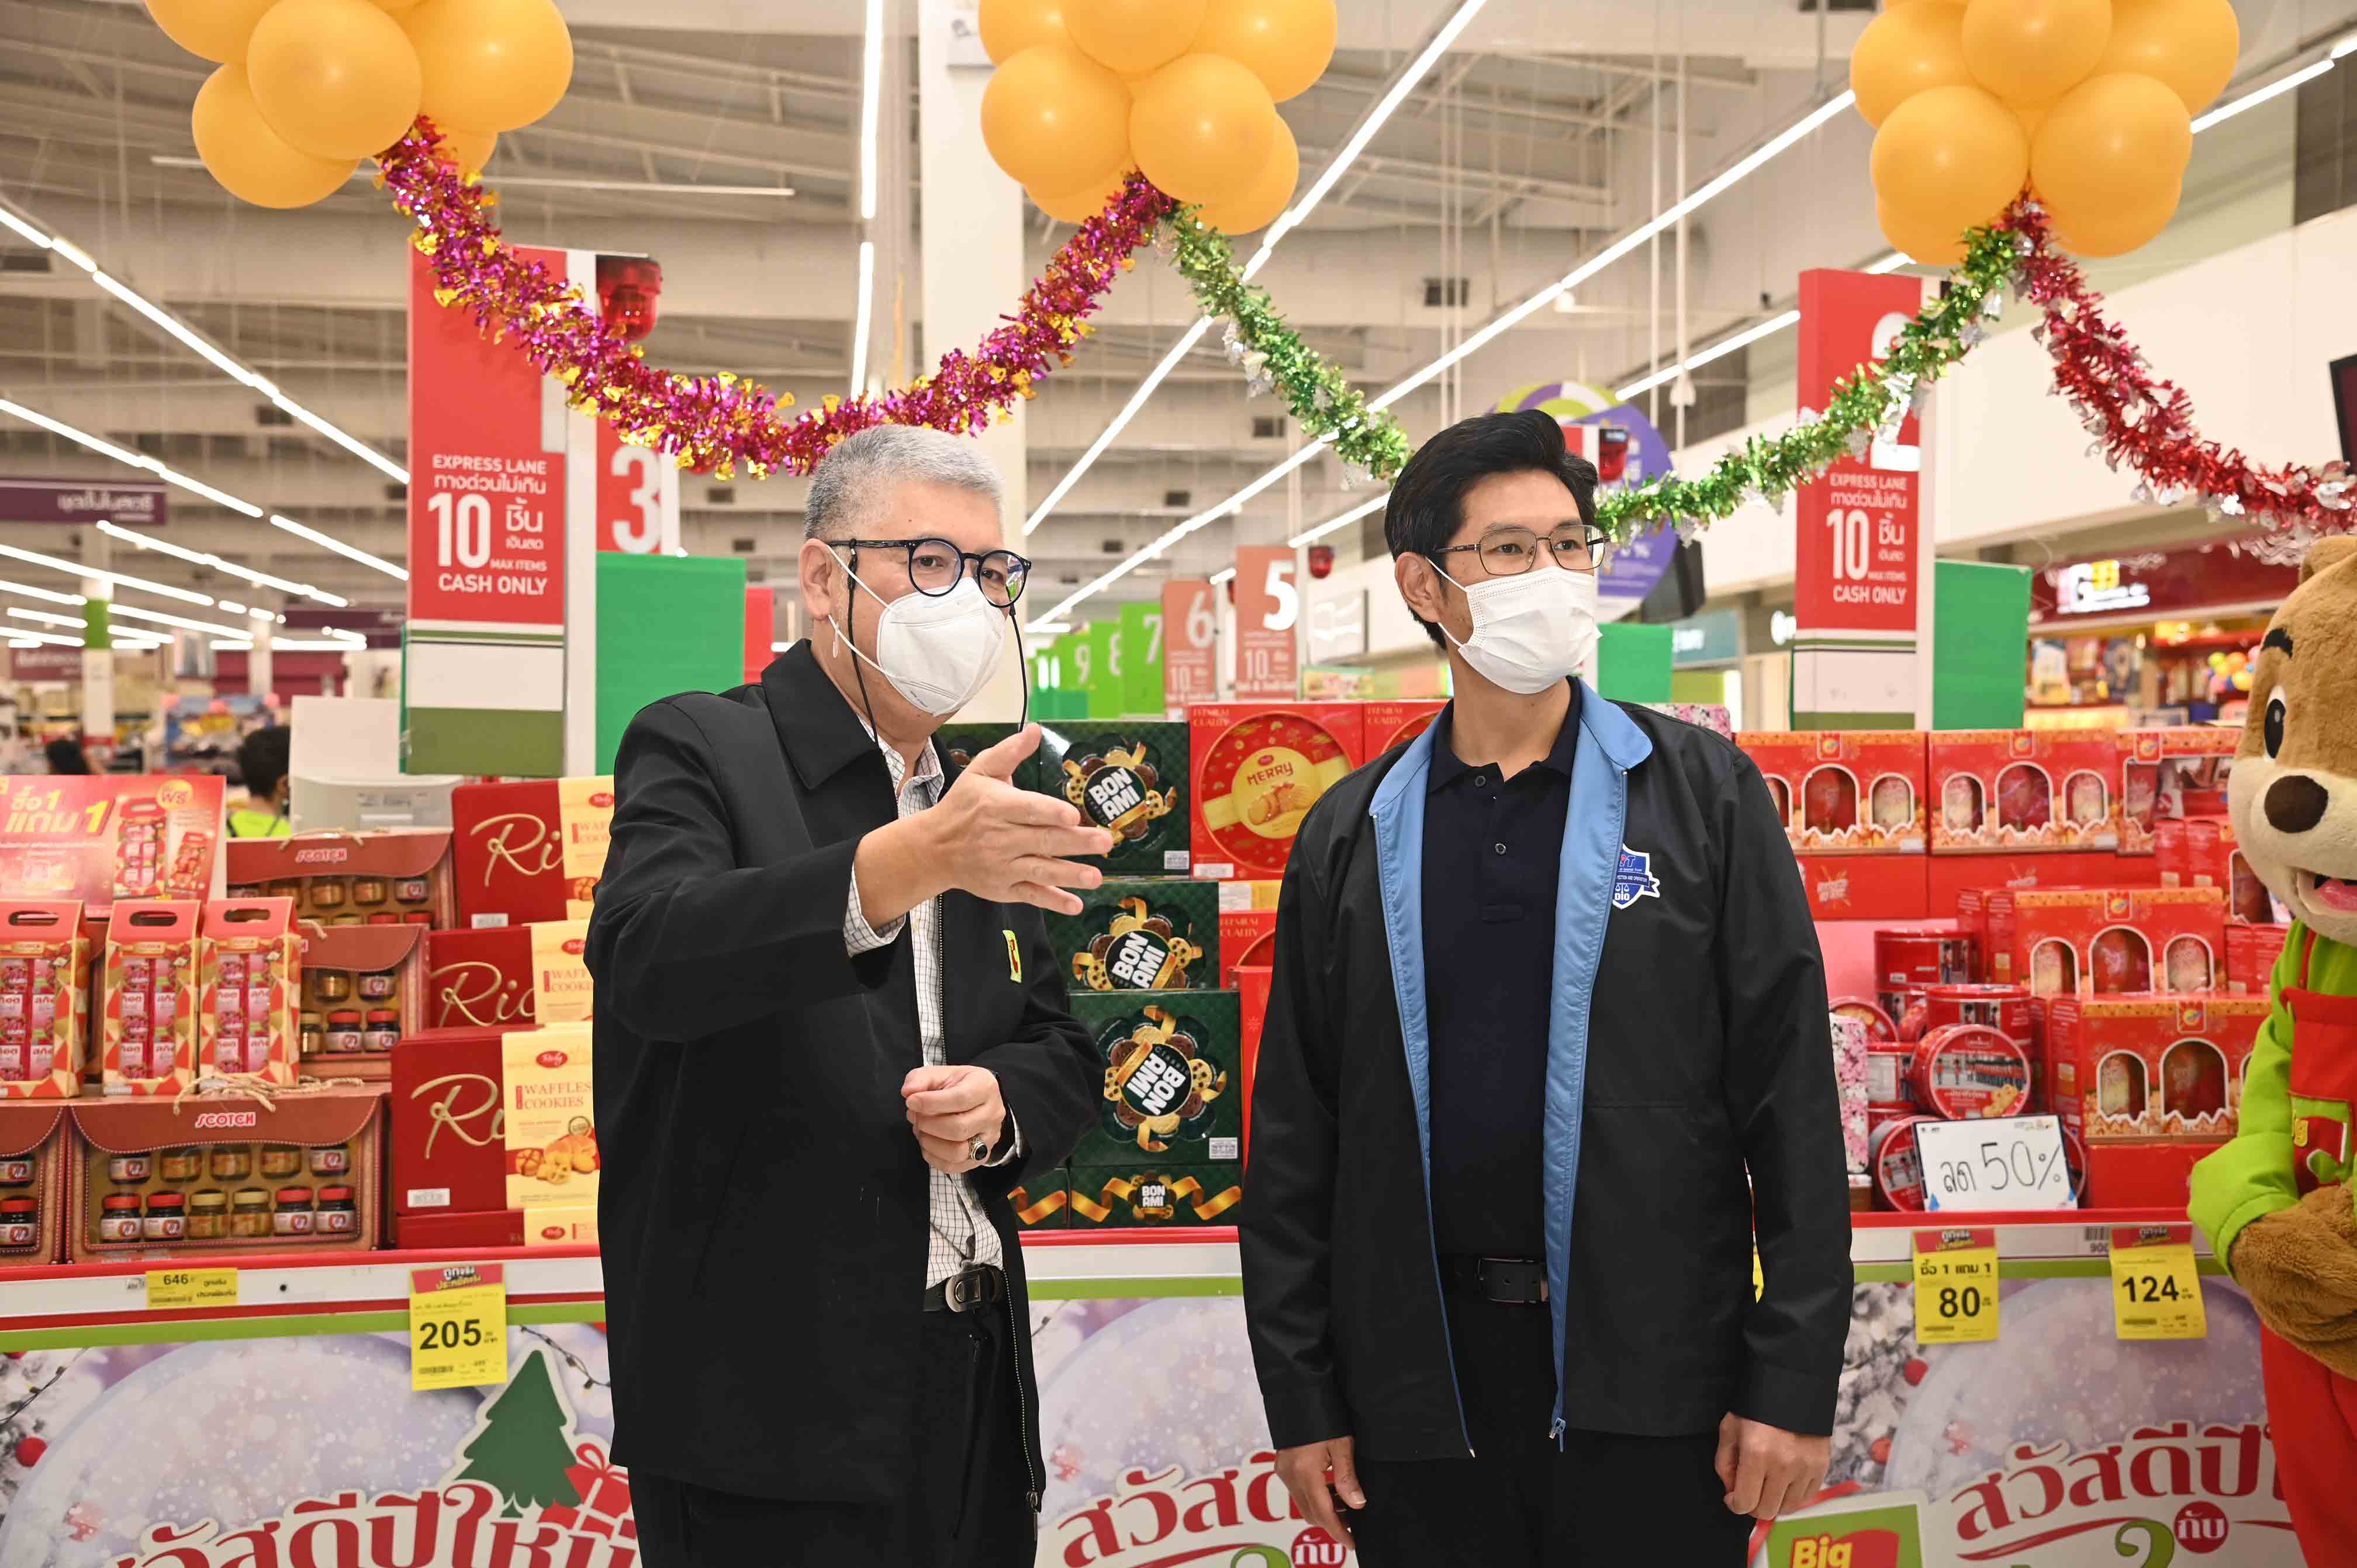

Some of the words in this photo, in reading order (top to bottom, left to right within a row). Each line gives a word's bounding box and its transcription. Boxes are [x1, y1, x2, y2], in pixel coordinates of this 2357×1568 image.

[433, 454, 502, 472] EXPRESS
[506, 459, 547, 475] LANE
[1830, 472, 1878, 489] EXPRESS
[1879, 476, 1908, 491] LANE
[505, 497, 544, 532] ชิ้น
[610, 445, 661, 555] 3
[428, 492, 491, 569] 10
[1826, 508, 1869, 580] 10
[1878, 511, 1905, 545] ชิ้น
[490, 558, 514, 570] MAX
[516, 559, 547, 572] ITEMS
[438, 573, 493, 593] CASH
[497, 575, 548, 596] ONLY
[1263, 559, 1299, 632] 5
[1833, 585, 1870, 603] CASH
[1872, 586, 1907, 605] ONLY
[1187, 590, 1215, 648] 6
[1143, 613, 1162, 665] 7
[1074, 644, 1091, 684] 9
[1088, 767, 1132, 805] BON
[1246, 761, 1294, 785] MERRY
[11, 785, 43, 811] ซื้อ
[47, 789, 61, 811] 1
[1102, 785, 1141, 821] AMI
[5, 812, 80, 833] แถม
[85, 799, 110, 833] 1
[1615, 892, 1630, 901] DIO
[1111, 932, 1149, 981] BON
[1132, 944, 1166, 988] AMI
[524, 1081, 591, 1095] WAFFLES
[1126, 1053, 1166, 1099] AMI
[1142, 1065, 1186, 1116] BON
[524, 1096, 584, 1109] COOKIES
[195, 1112, 256, 1129] SCOTCH
[1981, 1141, 2062, 1193] 50%
[1142, 1185, 1165, 1196] BON
[1142, 1196, 1164, 1207] AMI
[164, 1274, 189, 1285] 646
[1920, 1259, 1937, 1275] ซื้อ
[1943, 1264, 1949, 1275] 1
[1955, 1263, 1979, 1274] แถม
[1984, 1262, 1990, 1273] 1
[1939, 1287, 1981, 1318] 80
[2121, 1275, 2179, 1303] 124
[420, 1318, 482, 1350] 205
[1951, 1421, 2290, 1541] สวัสดีปี
[2178, 1509, 2224, 1539] กับ
[1295, 1533, 1343, 1566] กับ
[1792, 1535, 1853, 1568] Big
